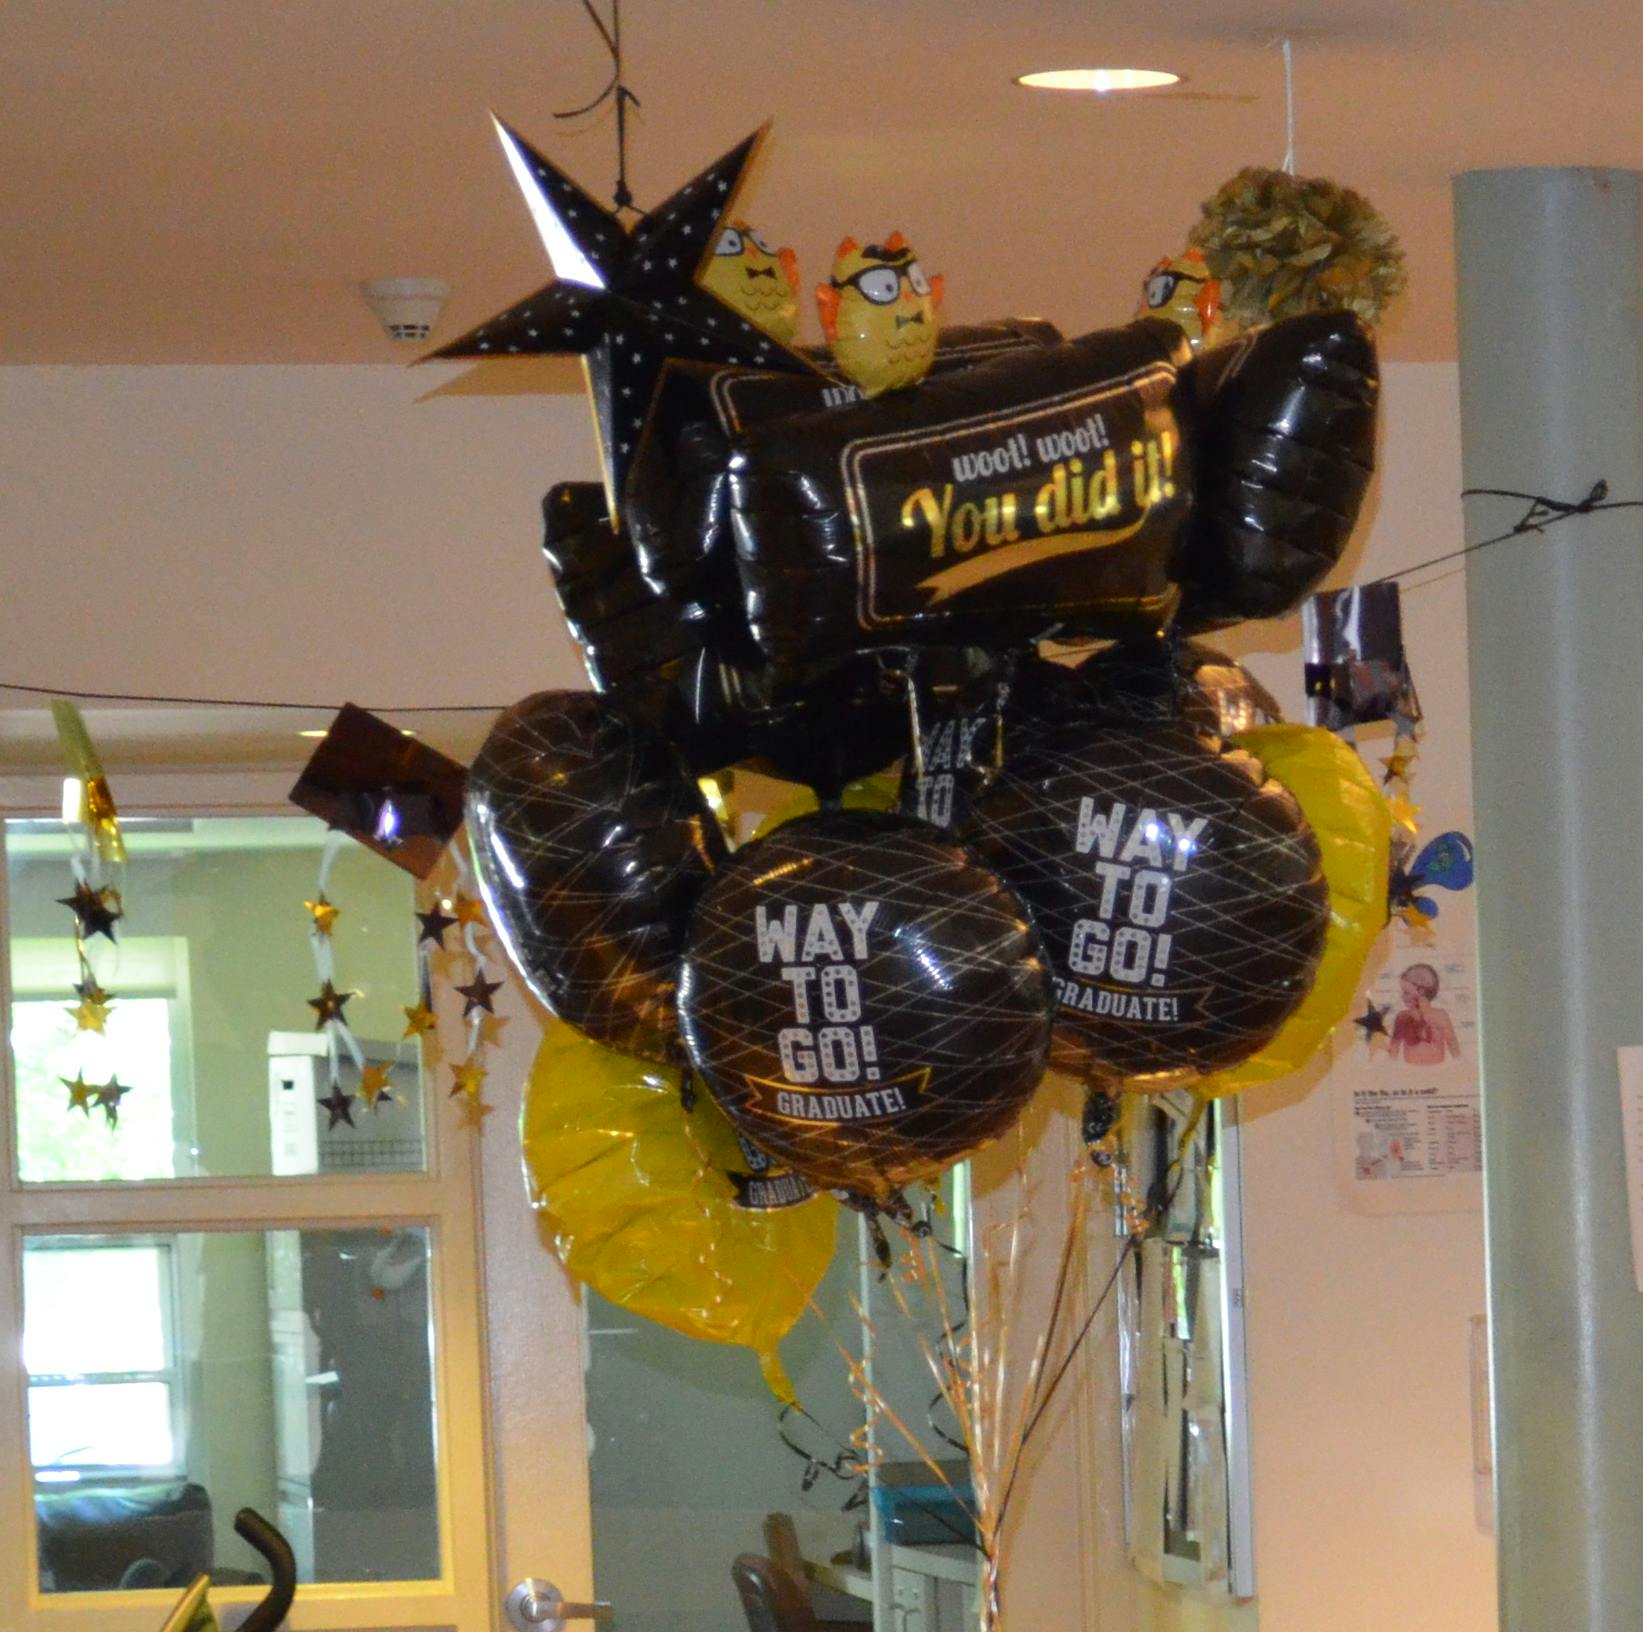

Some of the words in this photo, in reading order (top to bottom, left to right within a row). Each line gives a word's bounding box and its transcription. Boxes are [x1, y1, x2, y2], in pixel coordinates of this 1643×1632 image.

[953, 433, 1031, 482] woot!
[1036, 414, 1109, 463] woot!
[902, 483, 1021, 558] You
[1034, 450, 1121, 533] did
[1131, 431, 1175, 508] it!
[1075, 796, 1208, 871] WAY
[1095, 861, 1171, 928] TO
[755, 901, 879, 963] WAY
[1068, 919, 1172, 987] GO!
[781, 965, 861, 1024] TO
[1052, 976, 1179, 1021] GRADUATE!
[777, 1025, 881, 1083] GO!
[777, 1086, 907, 1120] GRADUATE!
